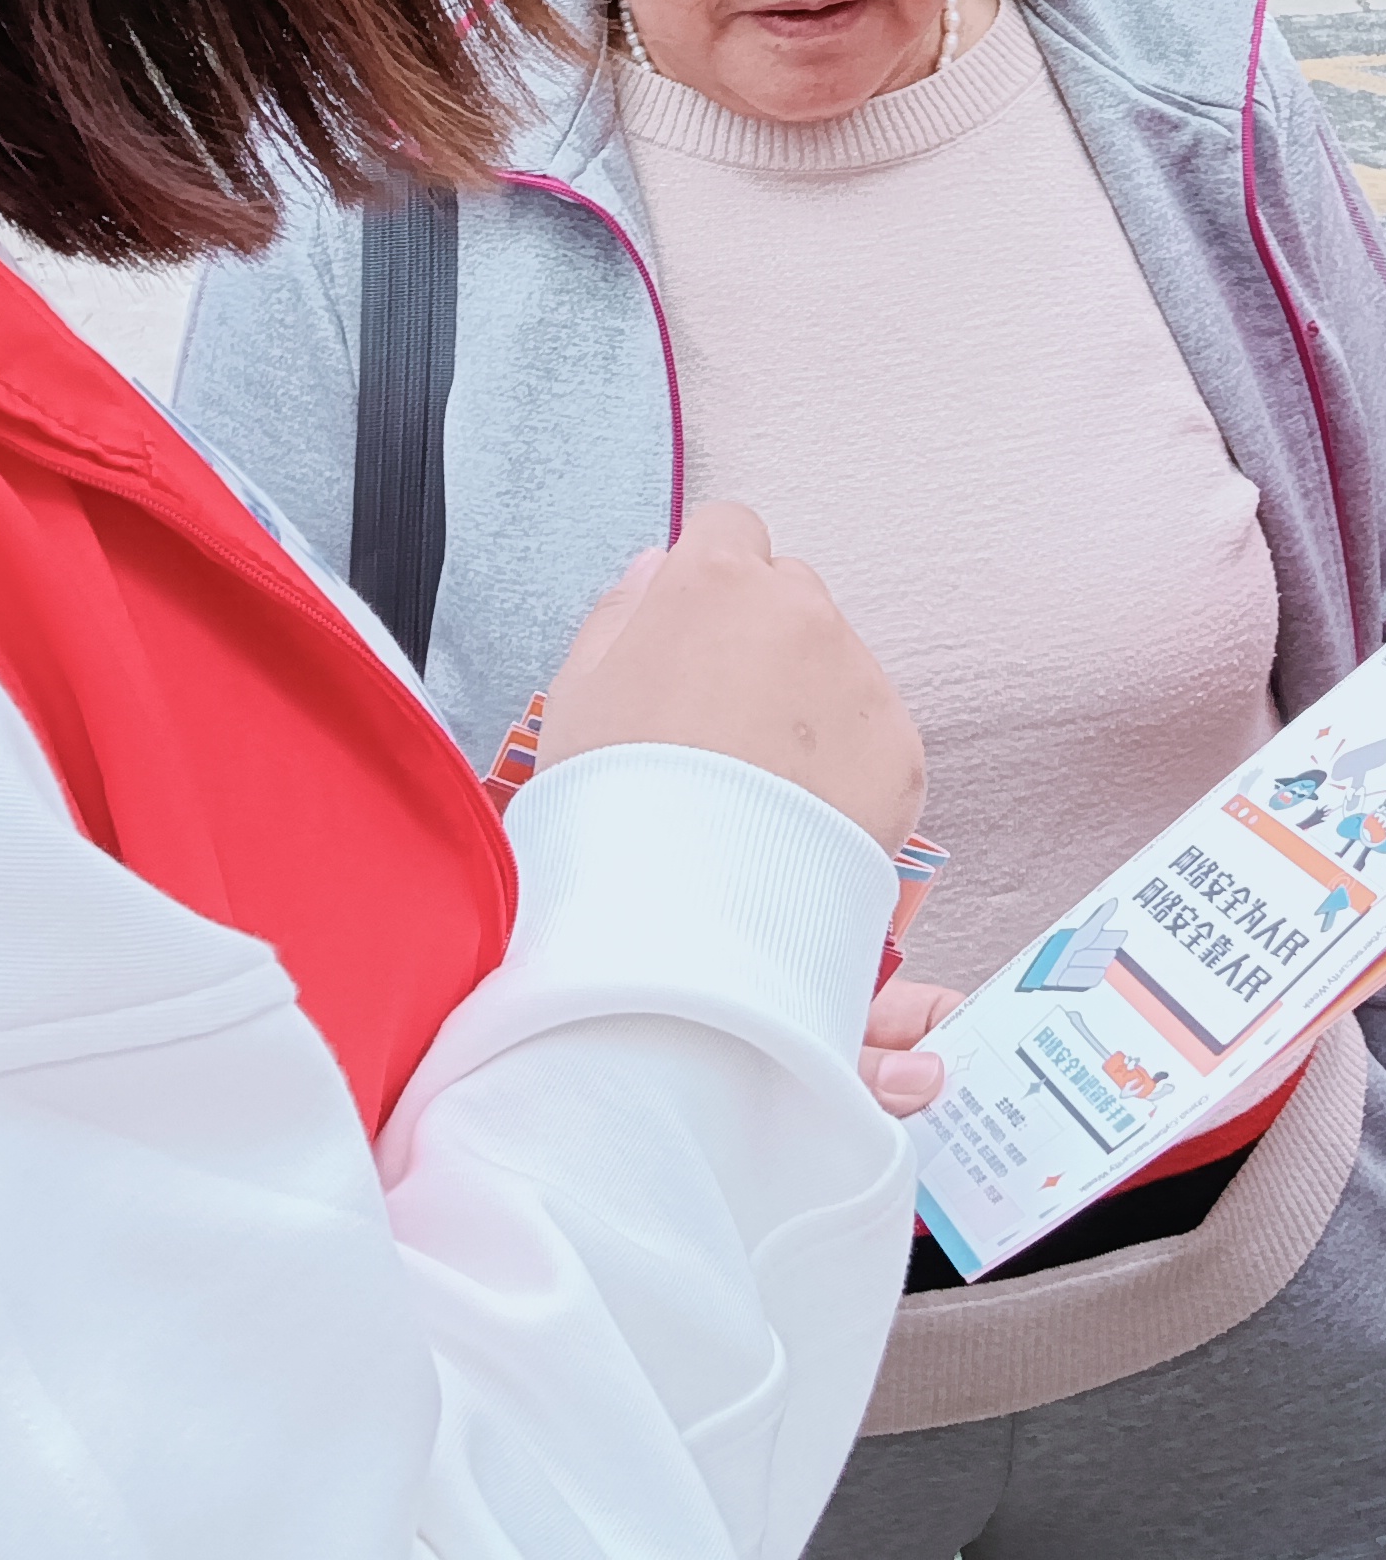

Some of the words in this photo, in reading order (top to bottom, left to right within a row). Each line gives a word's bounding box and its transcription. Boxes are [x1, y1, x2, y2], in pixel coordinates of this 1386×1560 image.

[1132, 876, 1273, 1003] 网络安全靠人民
[1168, 845, 1310, 966] 网络安全为人民
